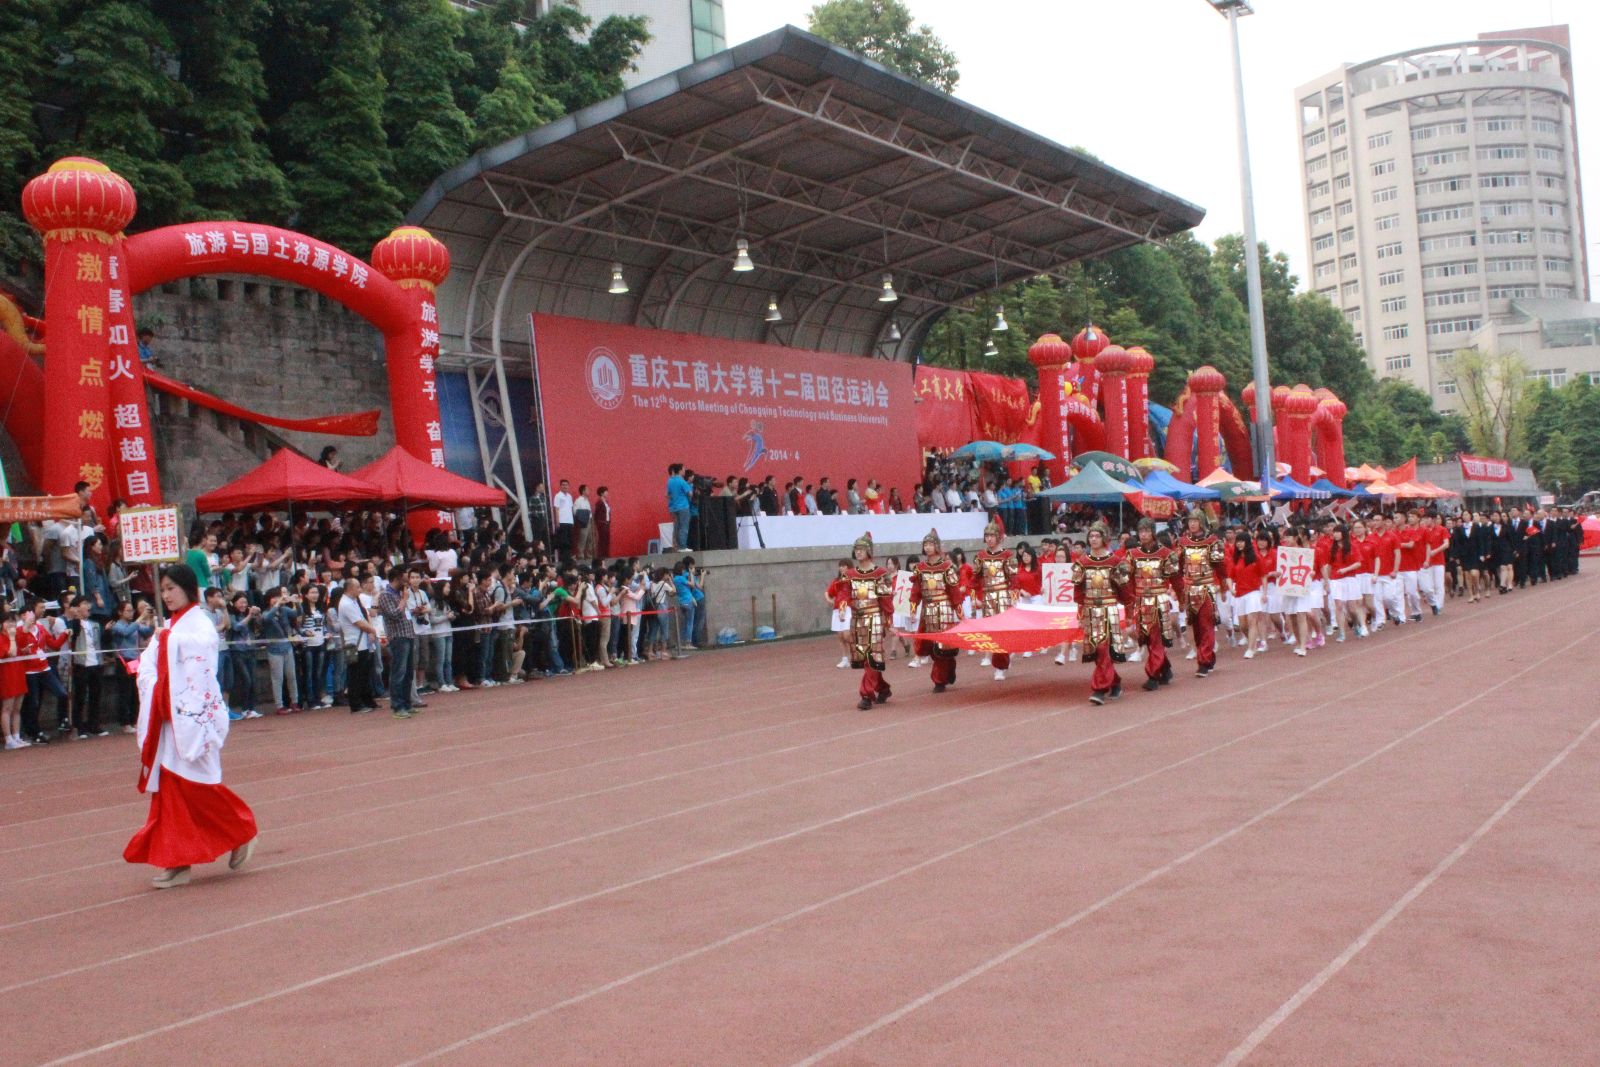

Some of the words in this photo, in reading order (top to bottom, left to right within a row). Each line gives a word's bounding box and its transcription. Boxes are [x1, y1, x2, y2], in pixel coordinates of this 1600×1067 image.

[184, 230, 369, 289] 旅游与国土资源学院
[76, 252, 105, 492] 激情点燃梦
[420, 300, 439, 401] 旅游学子
[628, 353, 889, 408] 重庆工商大学第十二届田径运动会
[631, 394, 649, 407] The
[650, 394, 667, 409] 12th
[669, 396, 696, 412] Sports
[698, 400, 729, 416] Meeting
[731, 402, 738, 413] of
[739, 403, 777, 418] Chongqing
[778, 406, 817, 421] Technology
[818, 409, 830, 420] and
[830, 410, 857, 422] Business
[858, 412, 888, 426] University
[113, 403, 151, 507] 超越自
[123, 512, 177, 534] 计算机科学与
[124, 535, 178, 557] 信息工程学院
[1278, 552, 1312, 588] 油
